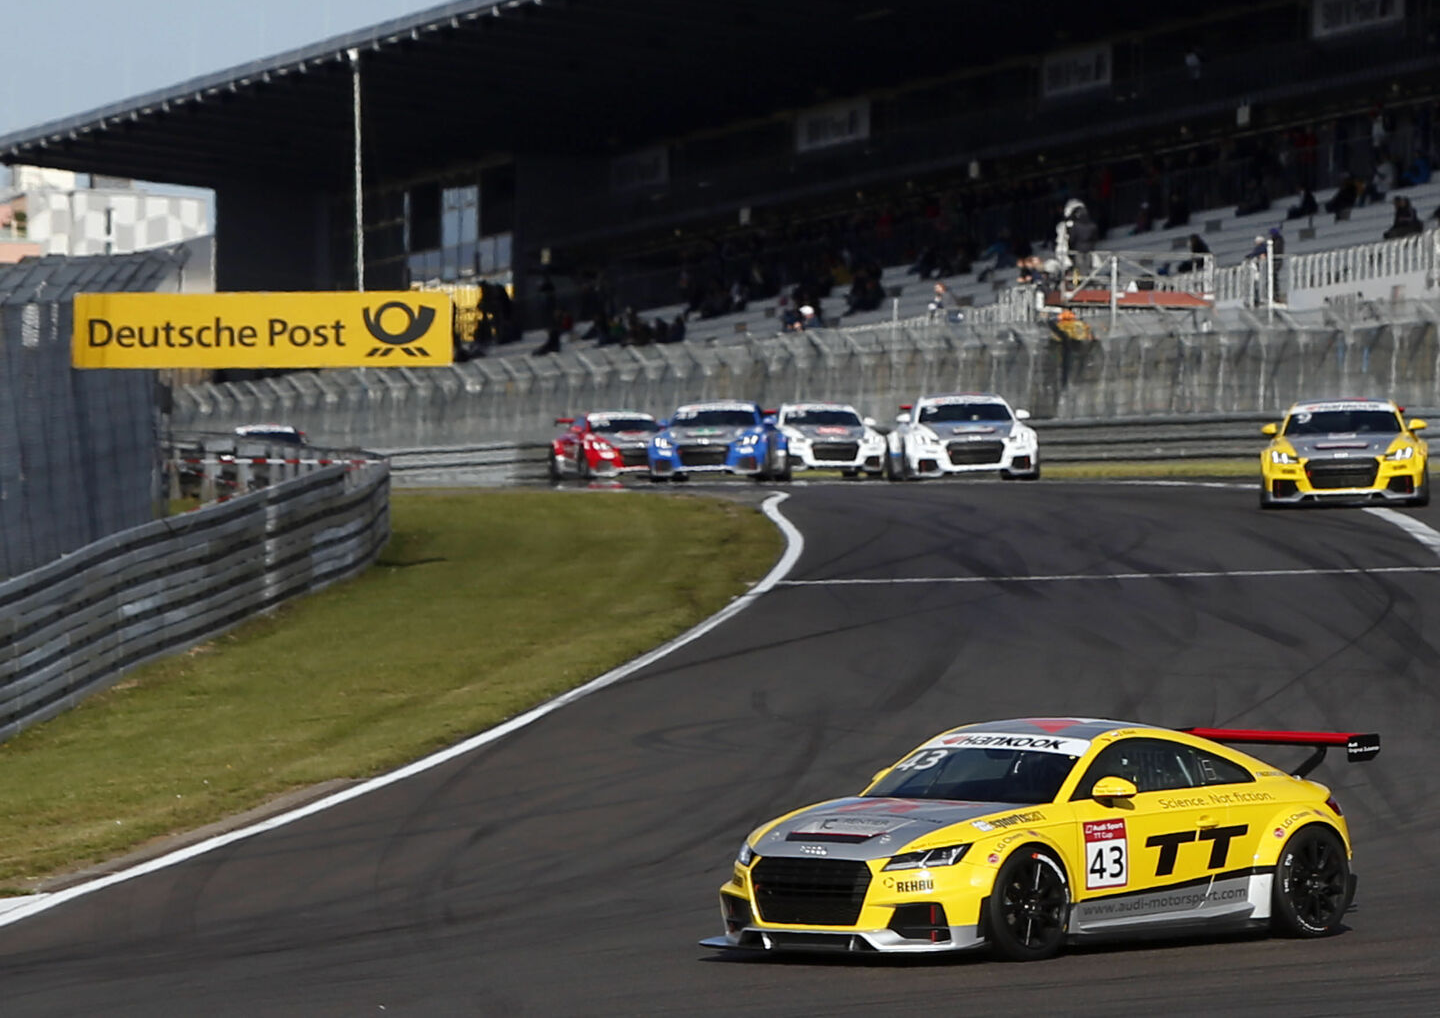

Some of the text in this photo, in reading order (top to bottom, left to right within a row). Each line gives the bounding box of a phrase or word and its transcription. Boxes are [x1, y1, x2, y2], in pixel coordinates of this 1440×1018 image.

[88, 318, 346, 348] Deutsche Post
[957, 734, 1069, 751] HANKOOK
[897, 749, 949, 772] 43
[1158, 790, 1276, 809] Science. Not fiction.
[1102, 831, 1113, 839] Cup
[1107, 822, 1124, 831] Sport
[1145, 824, 1249, 877] TT
[1089, 846, 1124, 879] 43
[896, 879, 934, 893] REHAU
[1083, 887, 1247, 916] www.audi-motorsport.com
